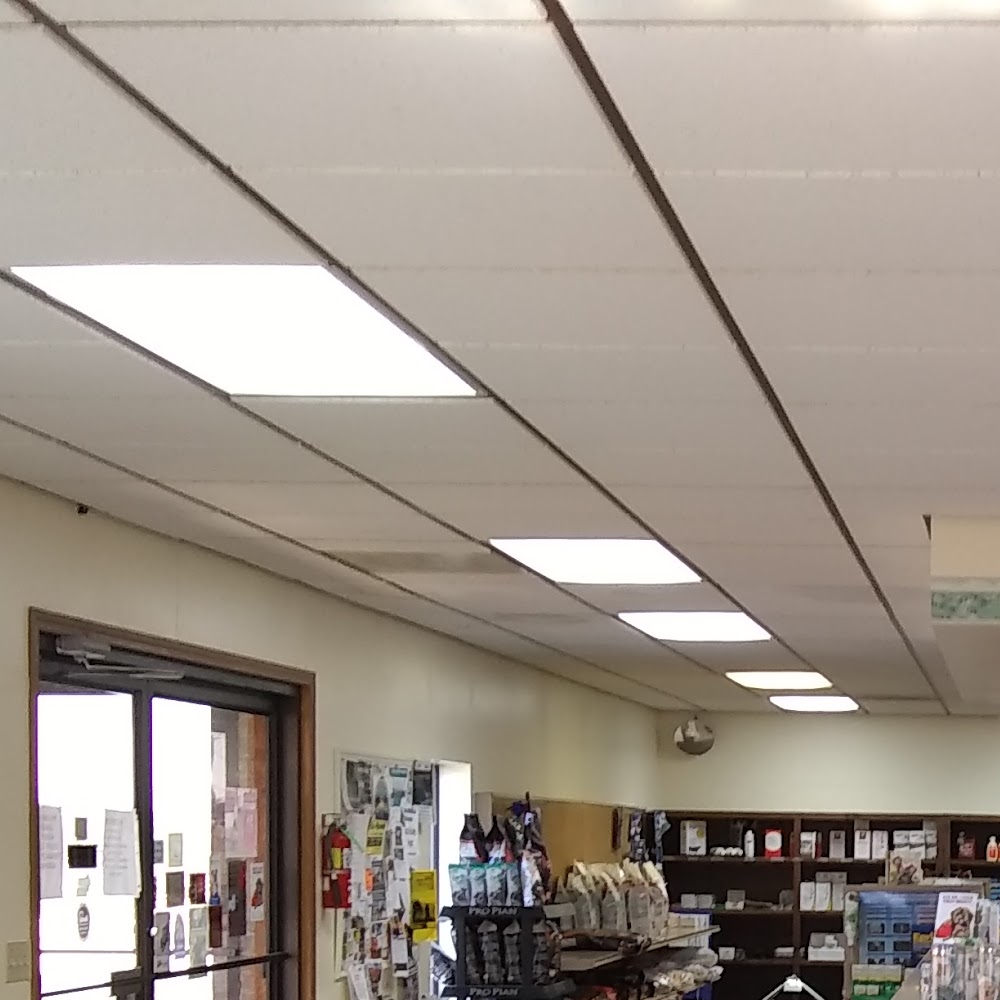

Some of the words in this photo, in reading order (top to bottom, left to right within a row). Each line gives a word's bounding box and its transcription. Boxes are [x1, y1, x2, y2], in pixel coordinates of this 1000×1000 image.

[468, 906, 491, 915] PRO
[492, 906, 518, 915] PLAN
[470, 987, 491, 996] PRO
[493, 987, 519, 996] PLAN
